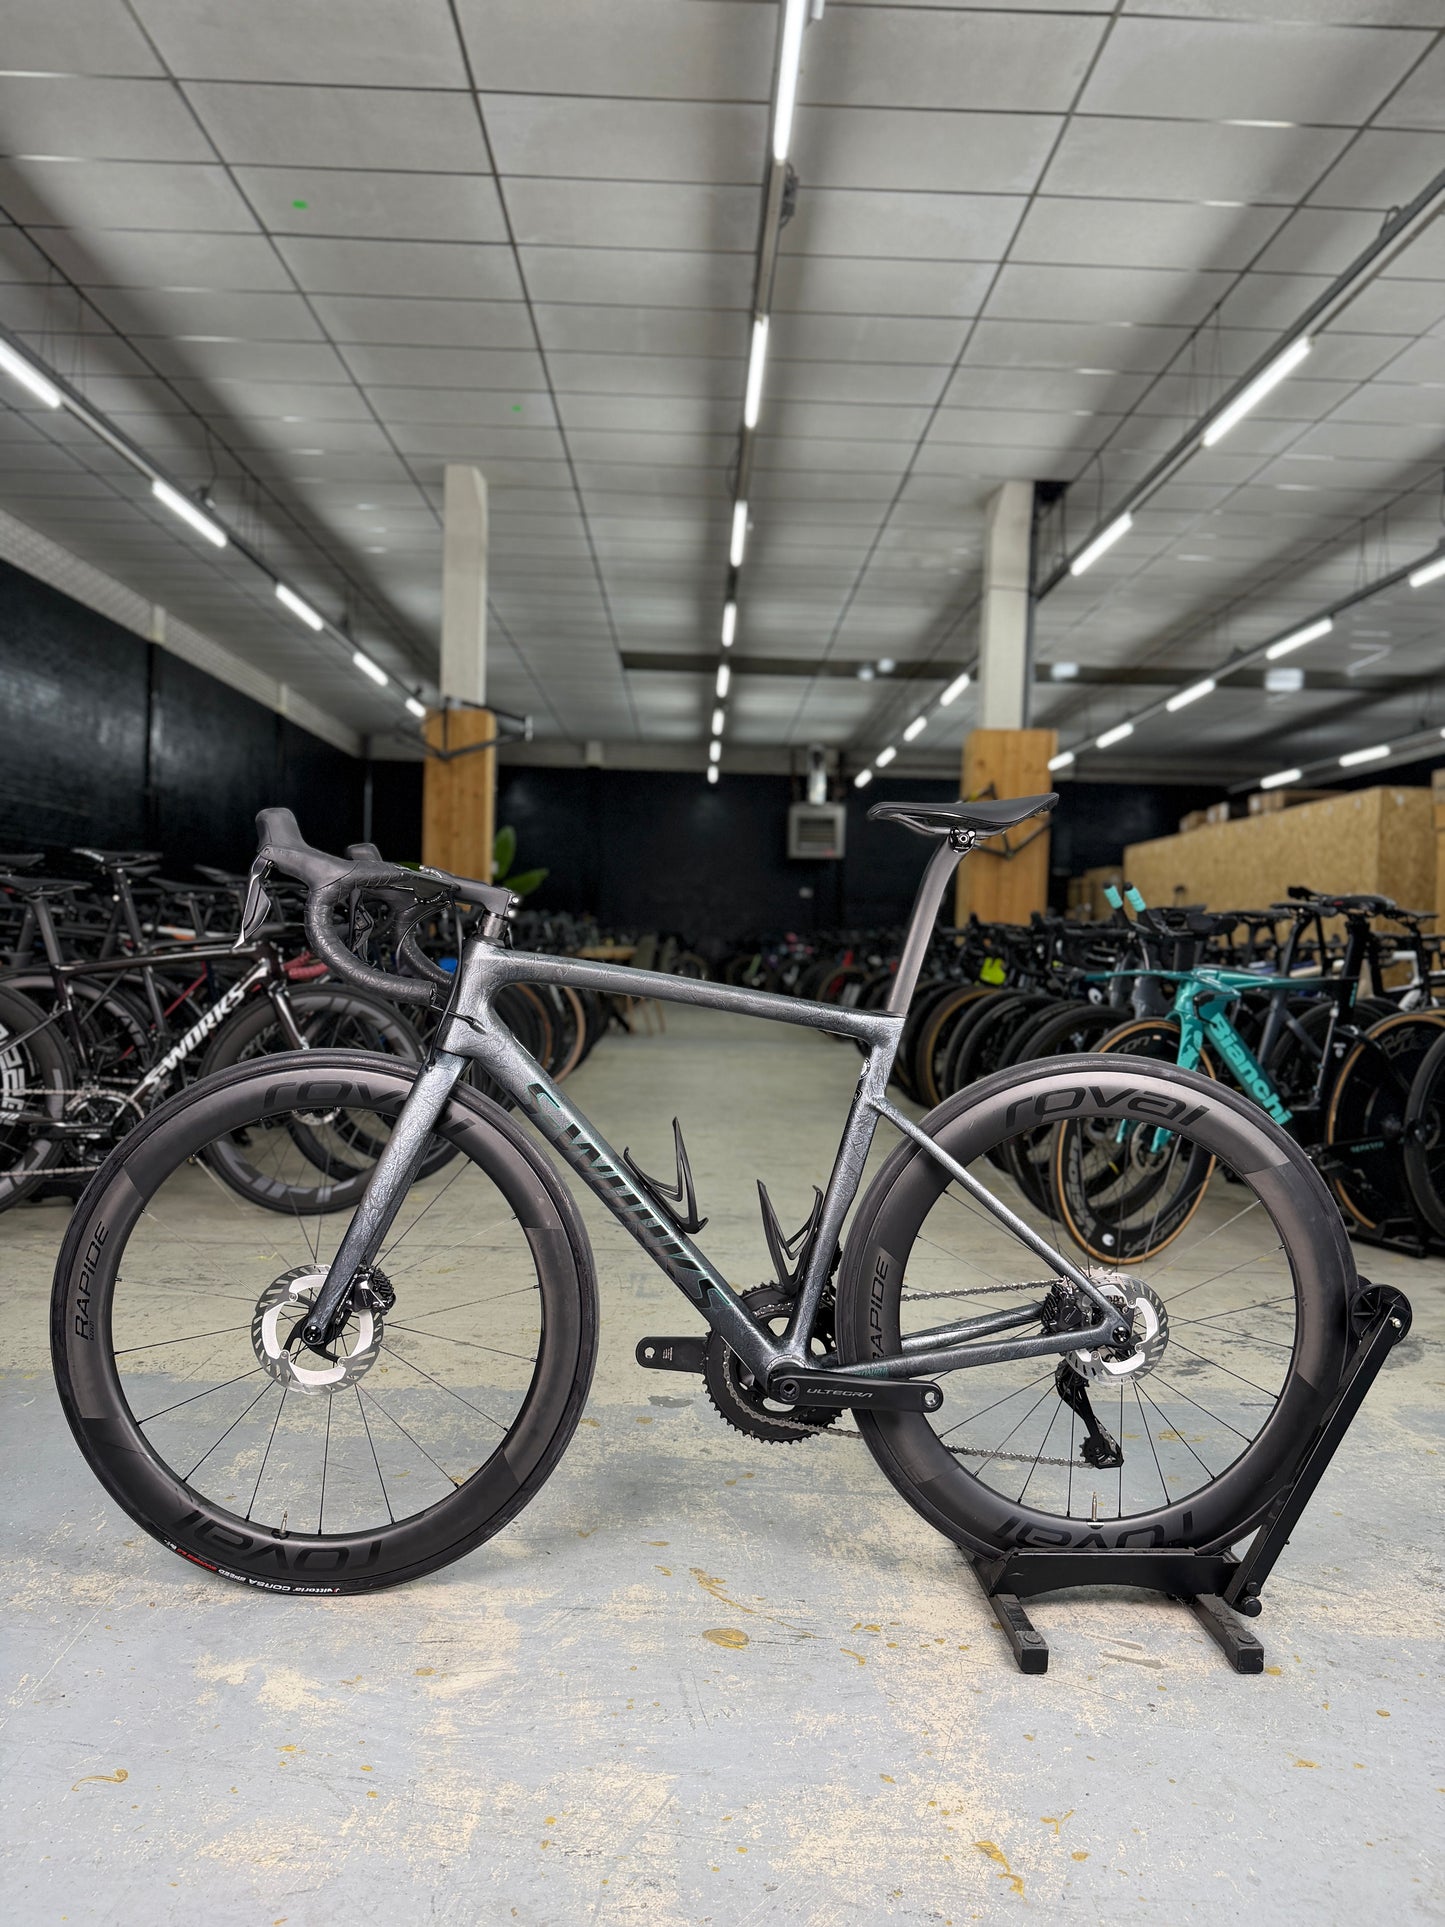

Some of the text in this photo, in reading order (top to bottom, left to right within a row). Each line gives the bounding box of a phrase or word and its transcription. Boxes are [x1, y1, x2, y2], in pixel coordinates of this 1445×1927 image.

[143, 982, 245, 1090] S-WORKS
[1209, 1012, 1293, 1126] Bianchi
[263, 1081, 476, 1137] rovl
[1005, 1086, 1210, 1129] roval
[75, 1220, 109, 1340] RAPIDE
[806, 1387, 873, 1398] ULTEGRA
[171, 1509, 383, 1573] roval
[248, 1578, 291, 1592] CORSA
